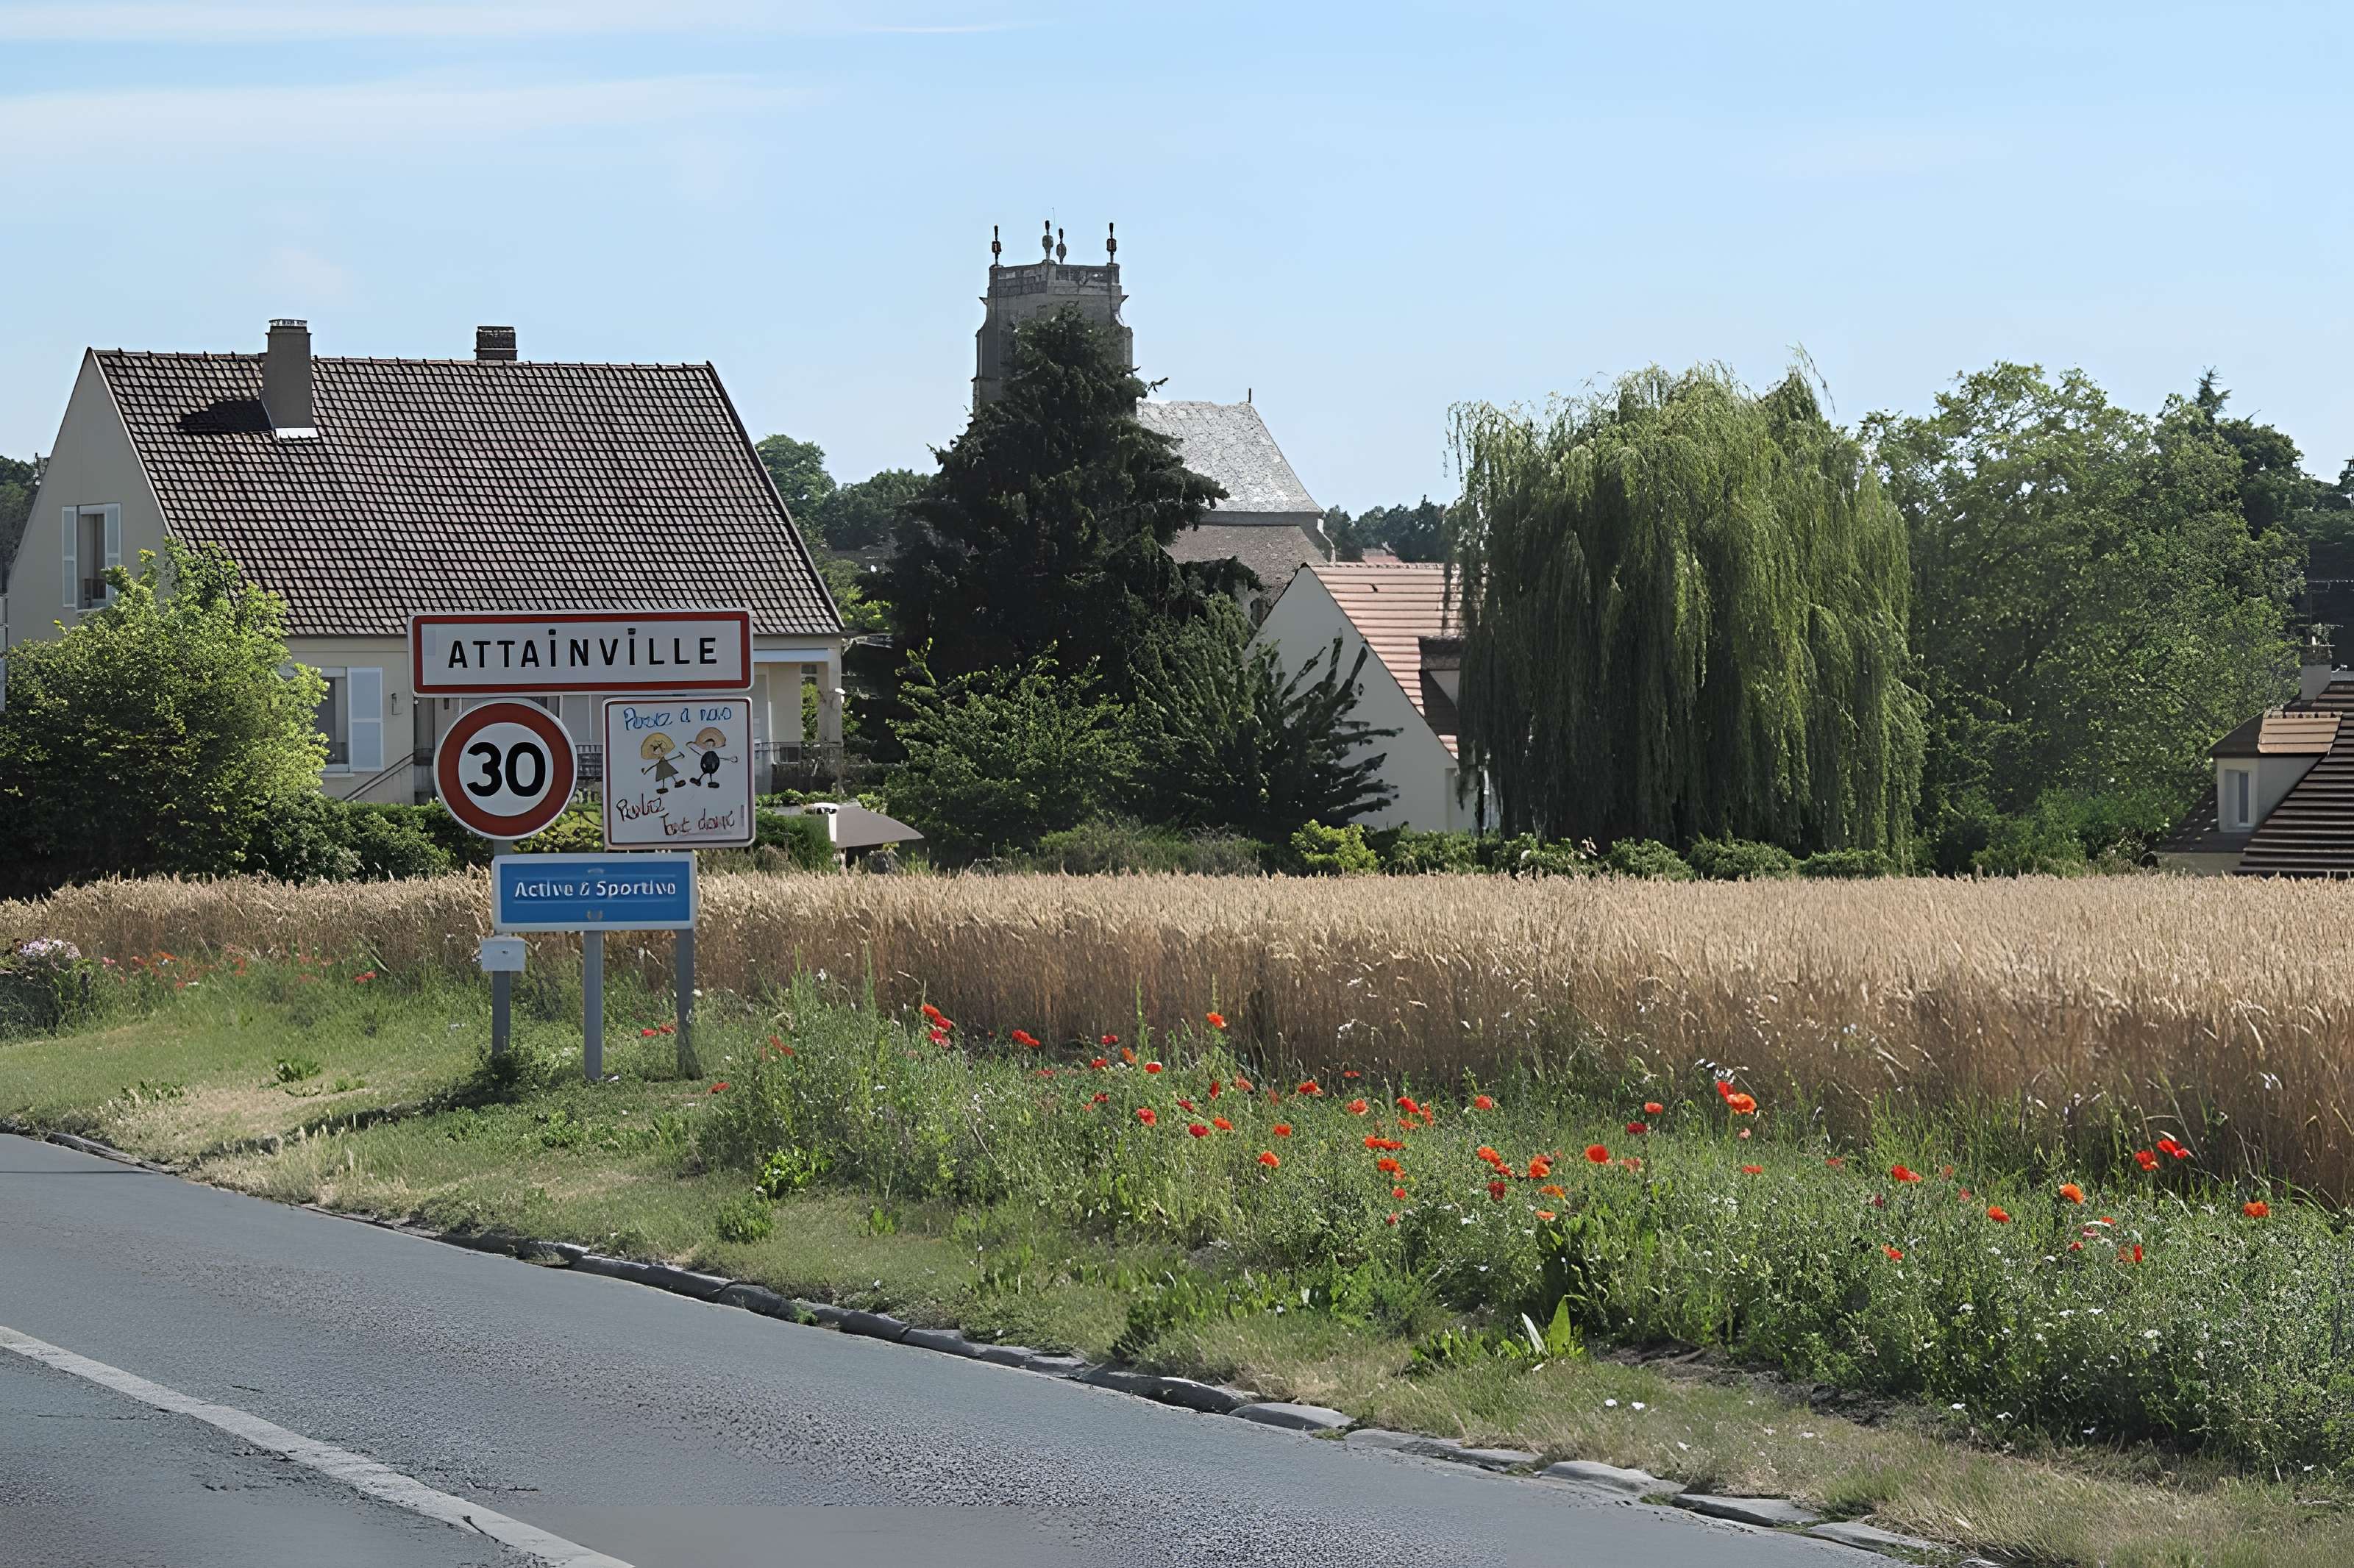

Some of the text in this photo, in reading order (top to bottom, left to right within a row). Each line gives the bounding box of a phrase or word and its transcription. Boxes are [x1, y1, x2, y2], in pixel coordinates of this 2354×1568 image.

[466, 741, 546, 797] 30
[515, 879, 573, 898] Active
[596, 879, 676, 899] Sportive
